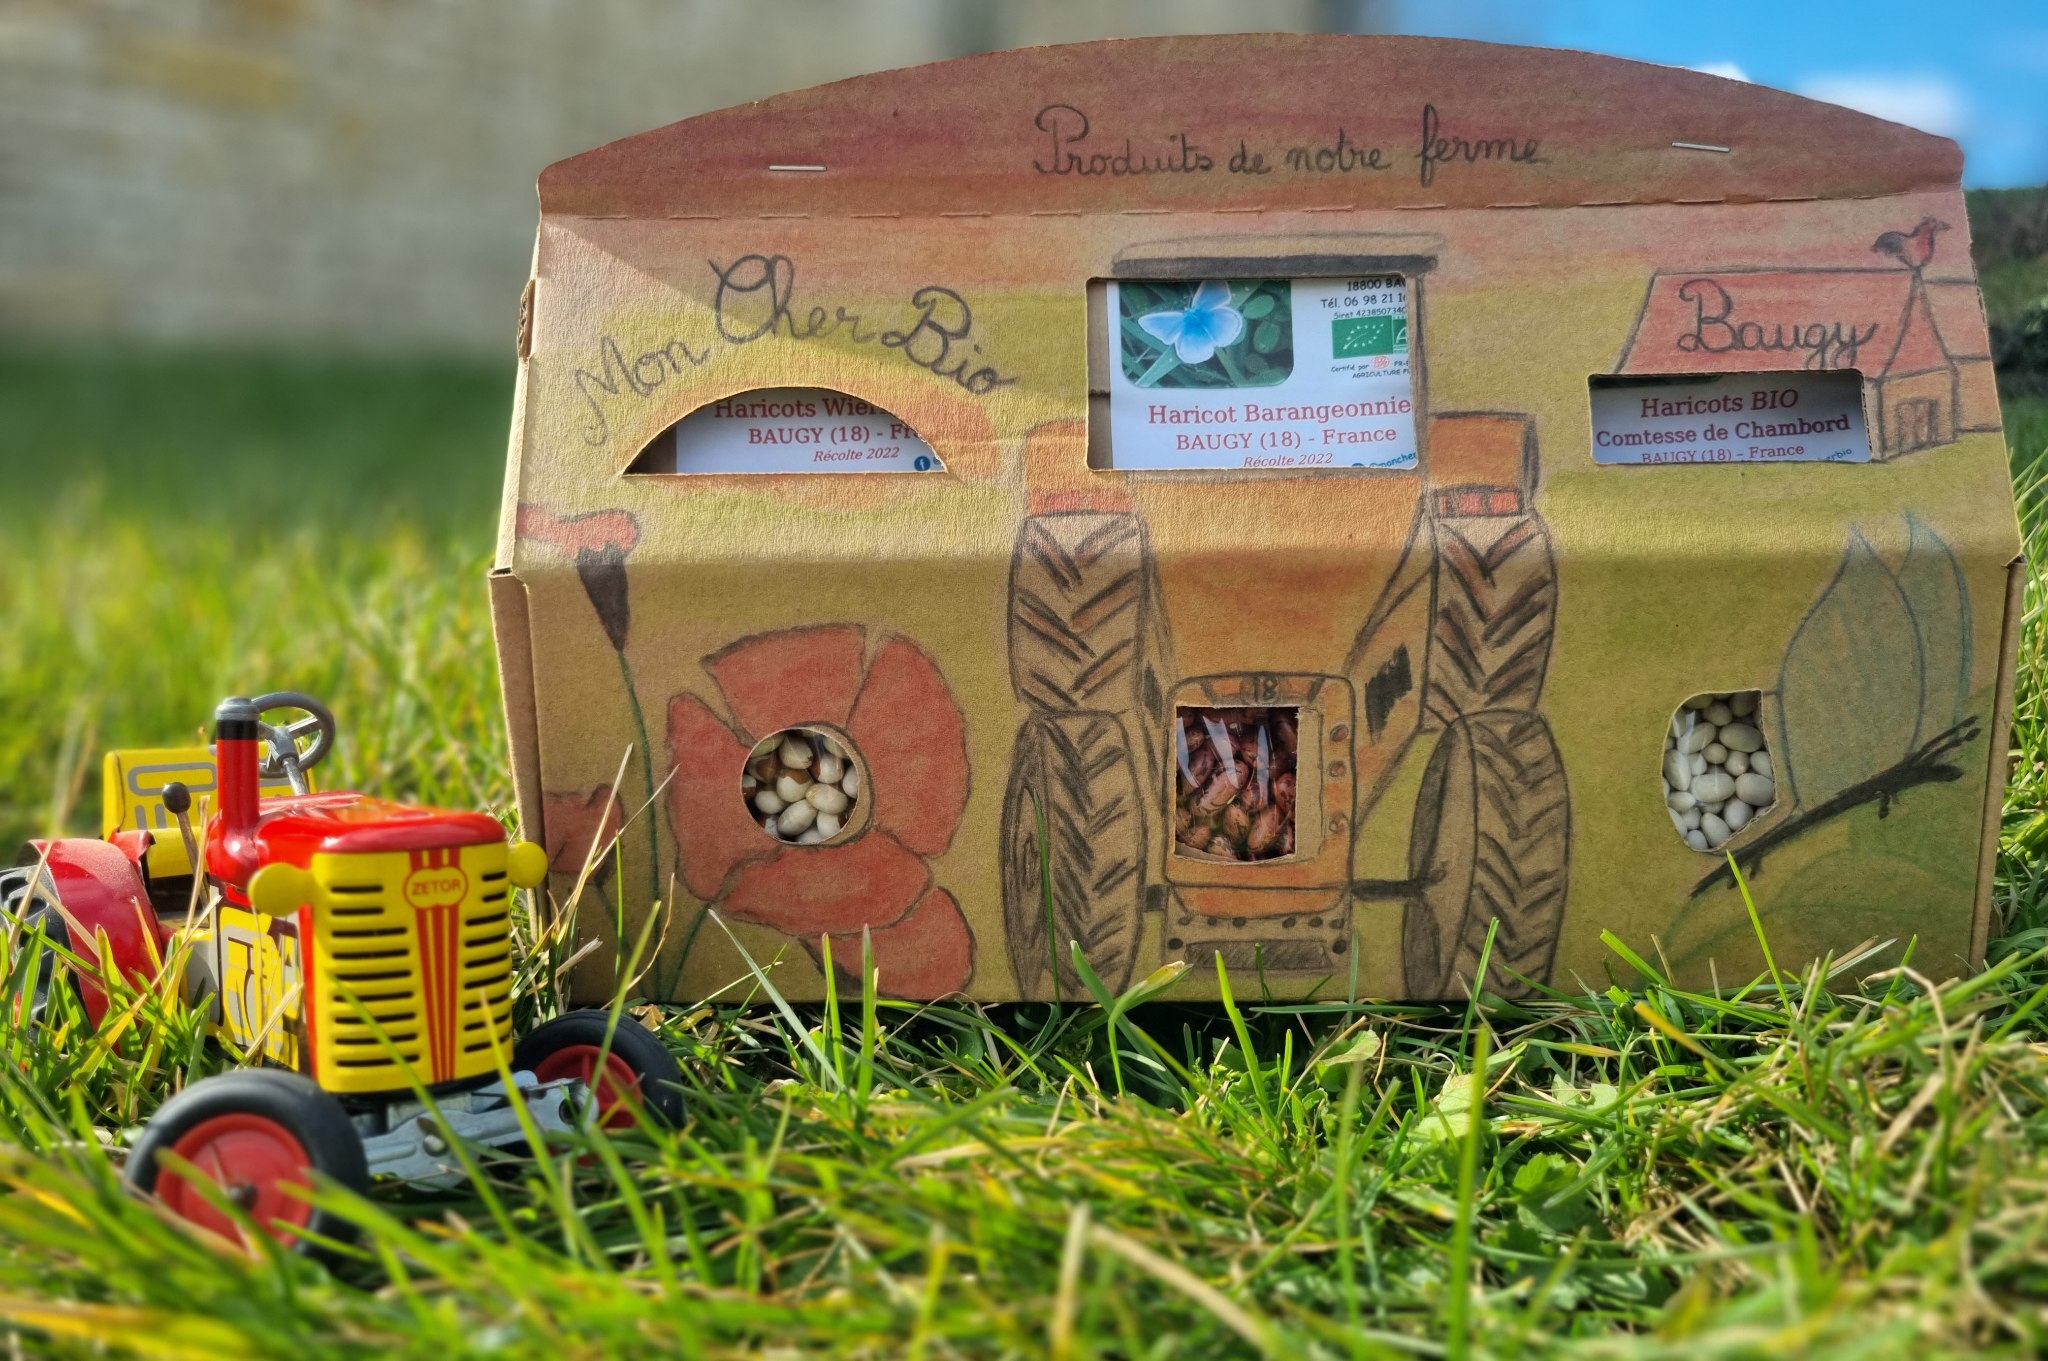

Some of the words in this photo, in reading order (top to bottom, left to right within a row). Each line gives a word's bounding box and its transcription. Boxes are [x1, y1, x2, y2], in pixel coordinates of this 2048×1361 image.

[1033, 104, 1214, 177] Produits
[1228, 139, 1272, 175] de
[1285, 127, 1391, 173] notre
[1416, 103, 1548, 188] ferme
[1347, 279, 1382, 292] 18800
[1343, 295, 1359, 307] 06
[1362, 294, 1378, 305] 98
[1381, 293, 1394, 304] 21
[1677, 278, 1880, 370] Baugy
[575, 336, 710, 447] Mon
[708, 254, 875, 344] Cher
[881, 286, 1018, 395] Bio
[714, 400, 817, 419] Haricots
[1148, 404, 1238, 425] Haricot
[1244, 396, 1413, 424] Barangeonnie
[1640, 394, 1743, 418] Haricots
[1750, 389, 1799, 411] BIO
[748, 427, 824, 445] BAUGY
[830, 425, 871, 445] (18)
[1176, 432, 1253, 451] BAUGY
[1259, 431, 1301, 450] (18)
[1322, 427, 1397, 445] France
[1596, 429, 1698, 448] Comtesse
[1703, 423, 1729, 442] de
[1734, 414, 1851, 440] Chambord
[812, 450, 864, 463] Récolte
[866, 446, 901, 460] 2022
[1243, 453, 1295, 468] Récolte
[1299, 453, 1333, 466] 2022
[1749, 444, 1805, 460] France
[1252, 671, 1280, 701] 18
[411, 877, 462, 897] ZETOR
